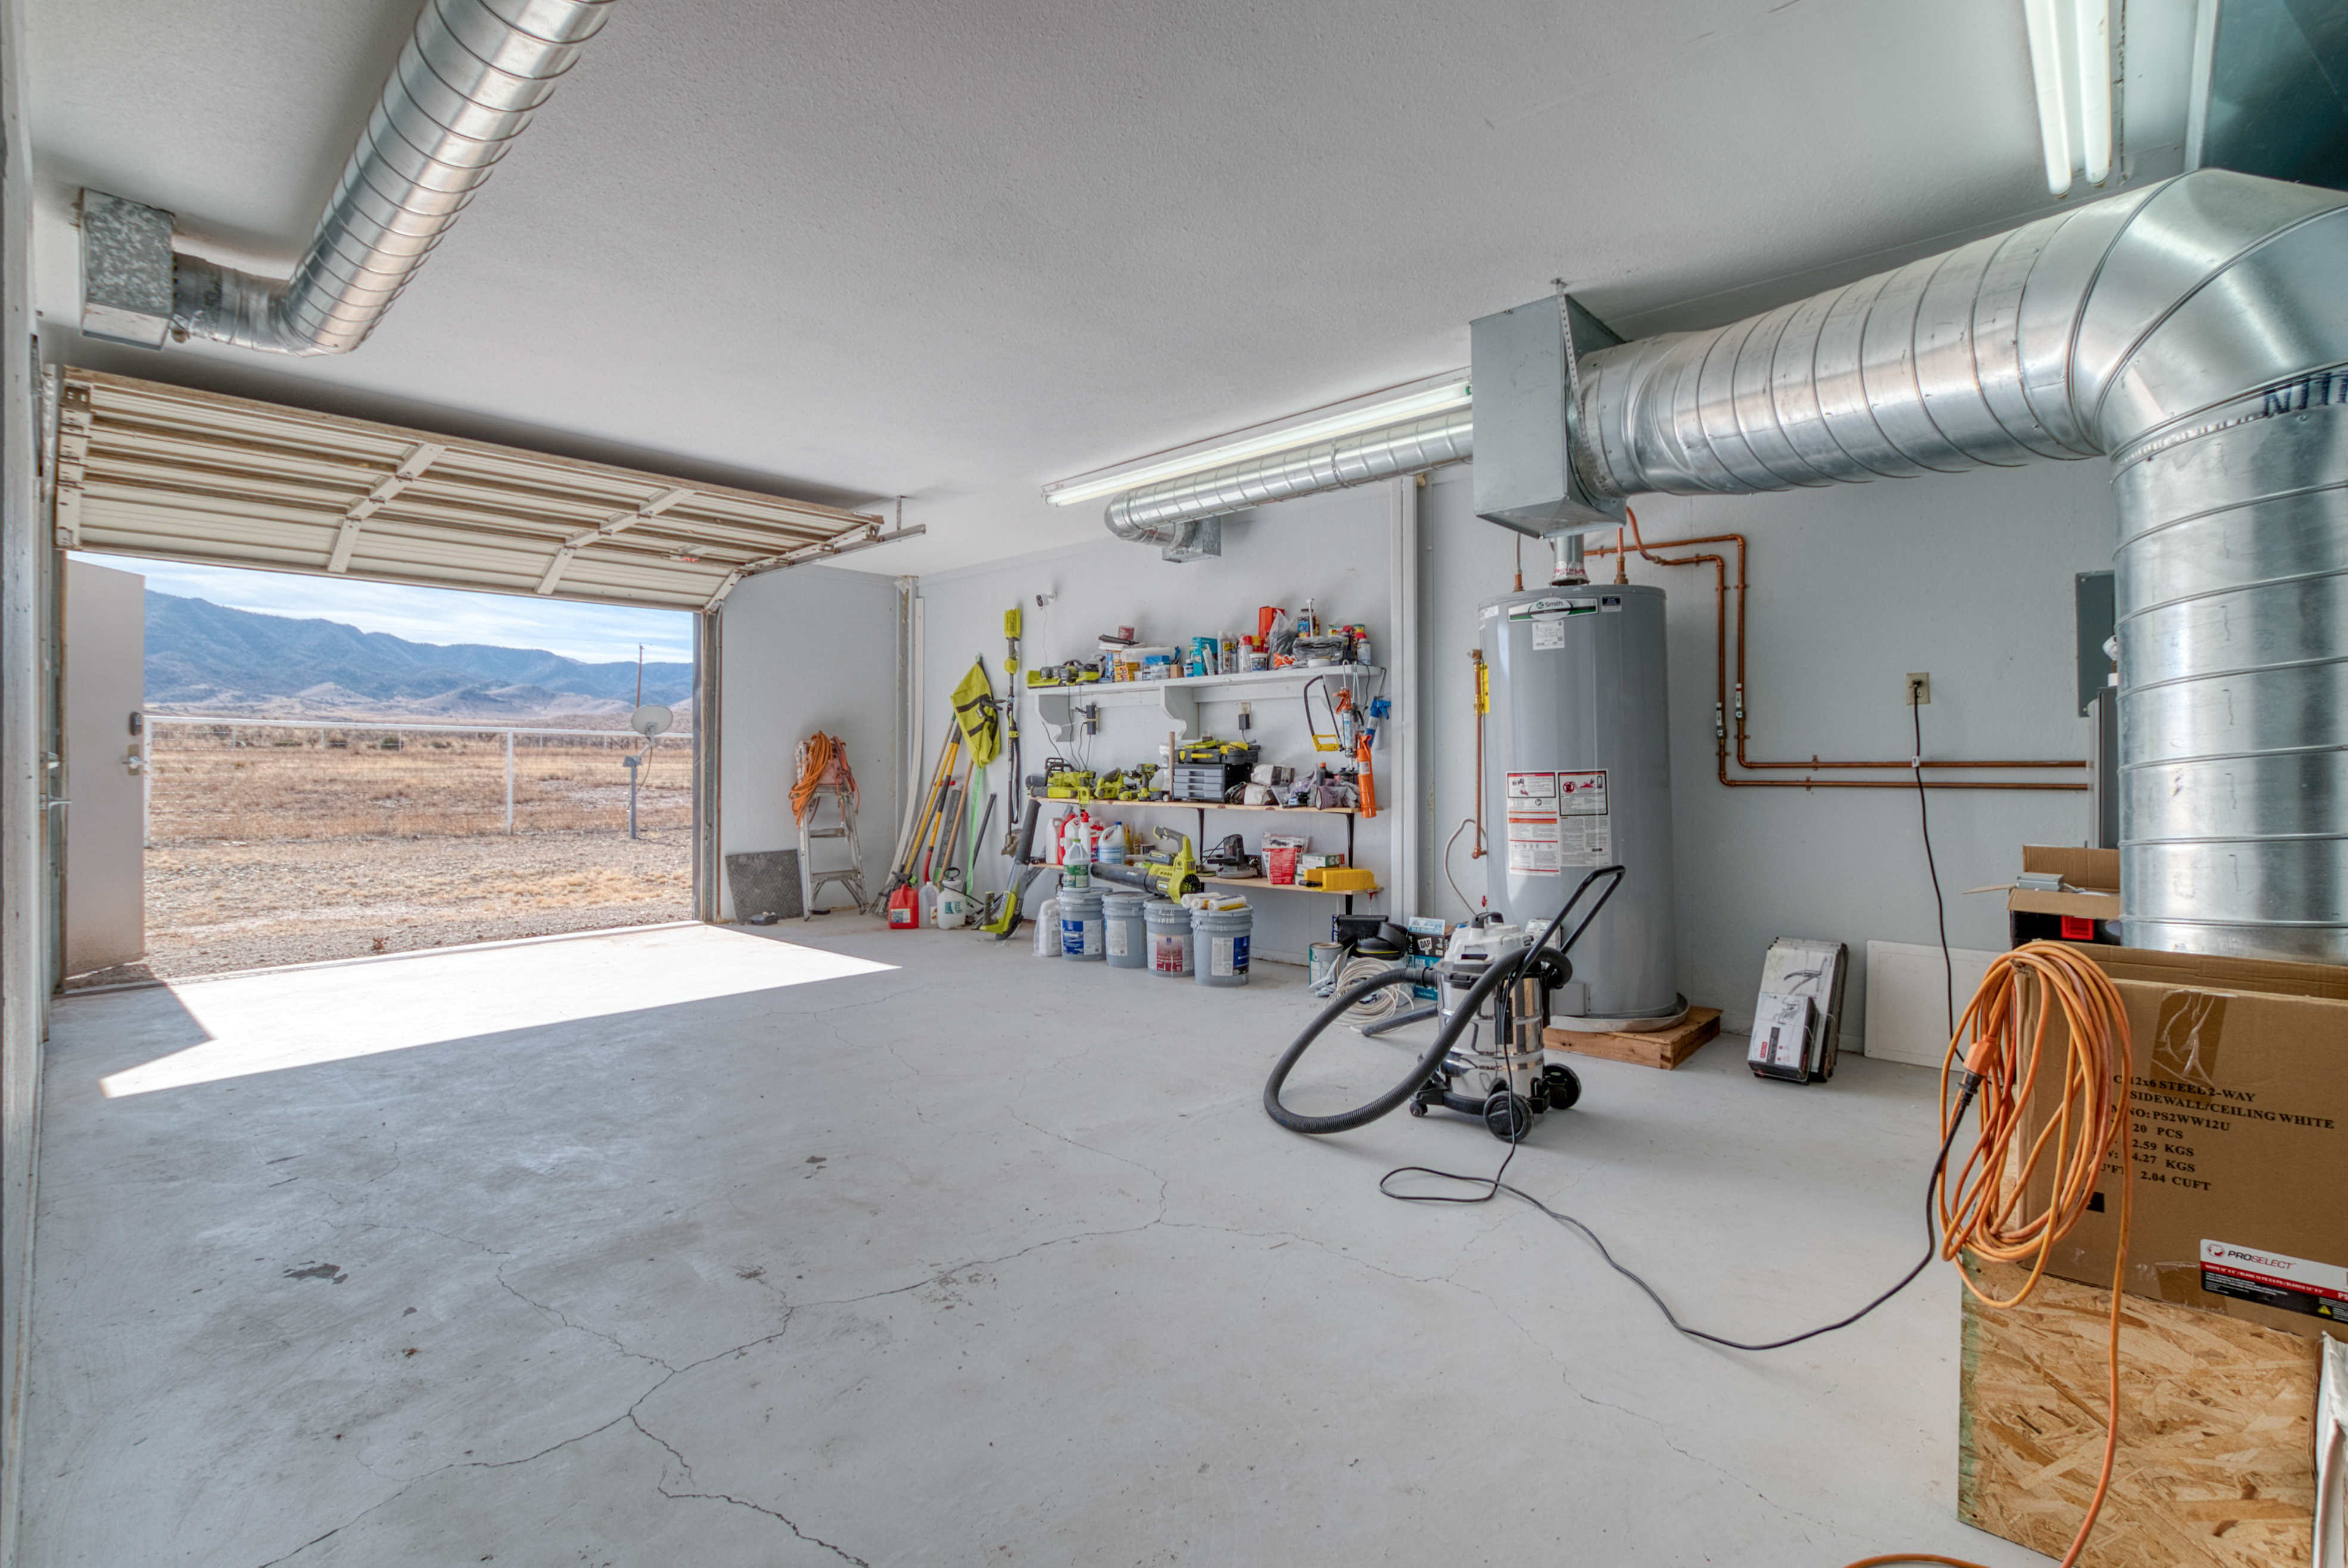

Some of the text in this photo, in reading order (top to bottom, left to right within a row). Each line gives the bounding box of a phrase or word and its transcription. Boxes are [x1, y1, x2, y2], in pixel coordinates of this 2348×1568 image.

[1419, 940, 1431, 949] DAP
[2159, 1080, 2207, 1095] STEEL
[2209, 1088, 2256, 1102] 2-WAY
[2130, 1091, 2335, 1129] SIDEWALL/CEILING WHITE
[2132, 1123, 2184, 1139] 20 PCS
[2153, 1111, 2231, 1131] PS2WW12U
[2132, 1139, 2194, 1156] 2.59 KGS
[2131, 1152, 2157, 1164] 4.27
[2165, 1159, 2196, 1173] KGS
[2140, 1171, 2166, 1183] 2.04
[2172, 1176, 2211, 1191] CUFT
[2227, 1250, 2293, 1270] PROSELECT
[2286, 1282, 2306, 1290] BLANCO
